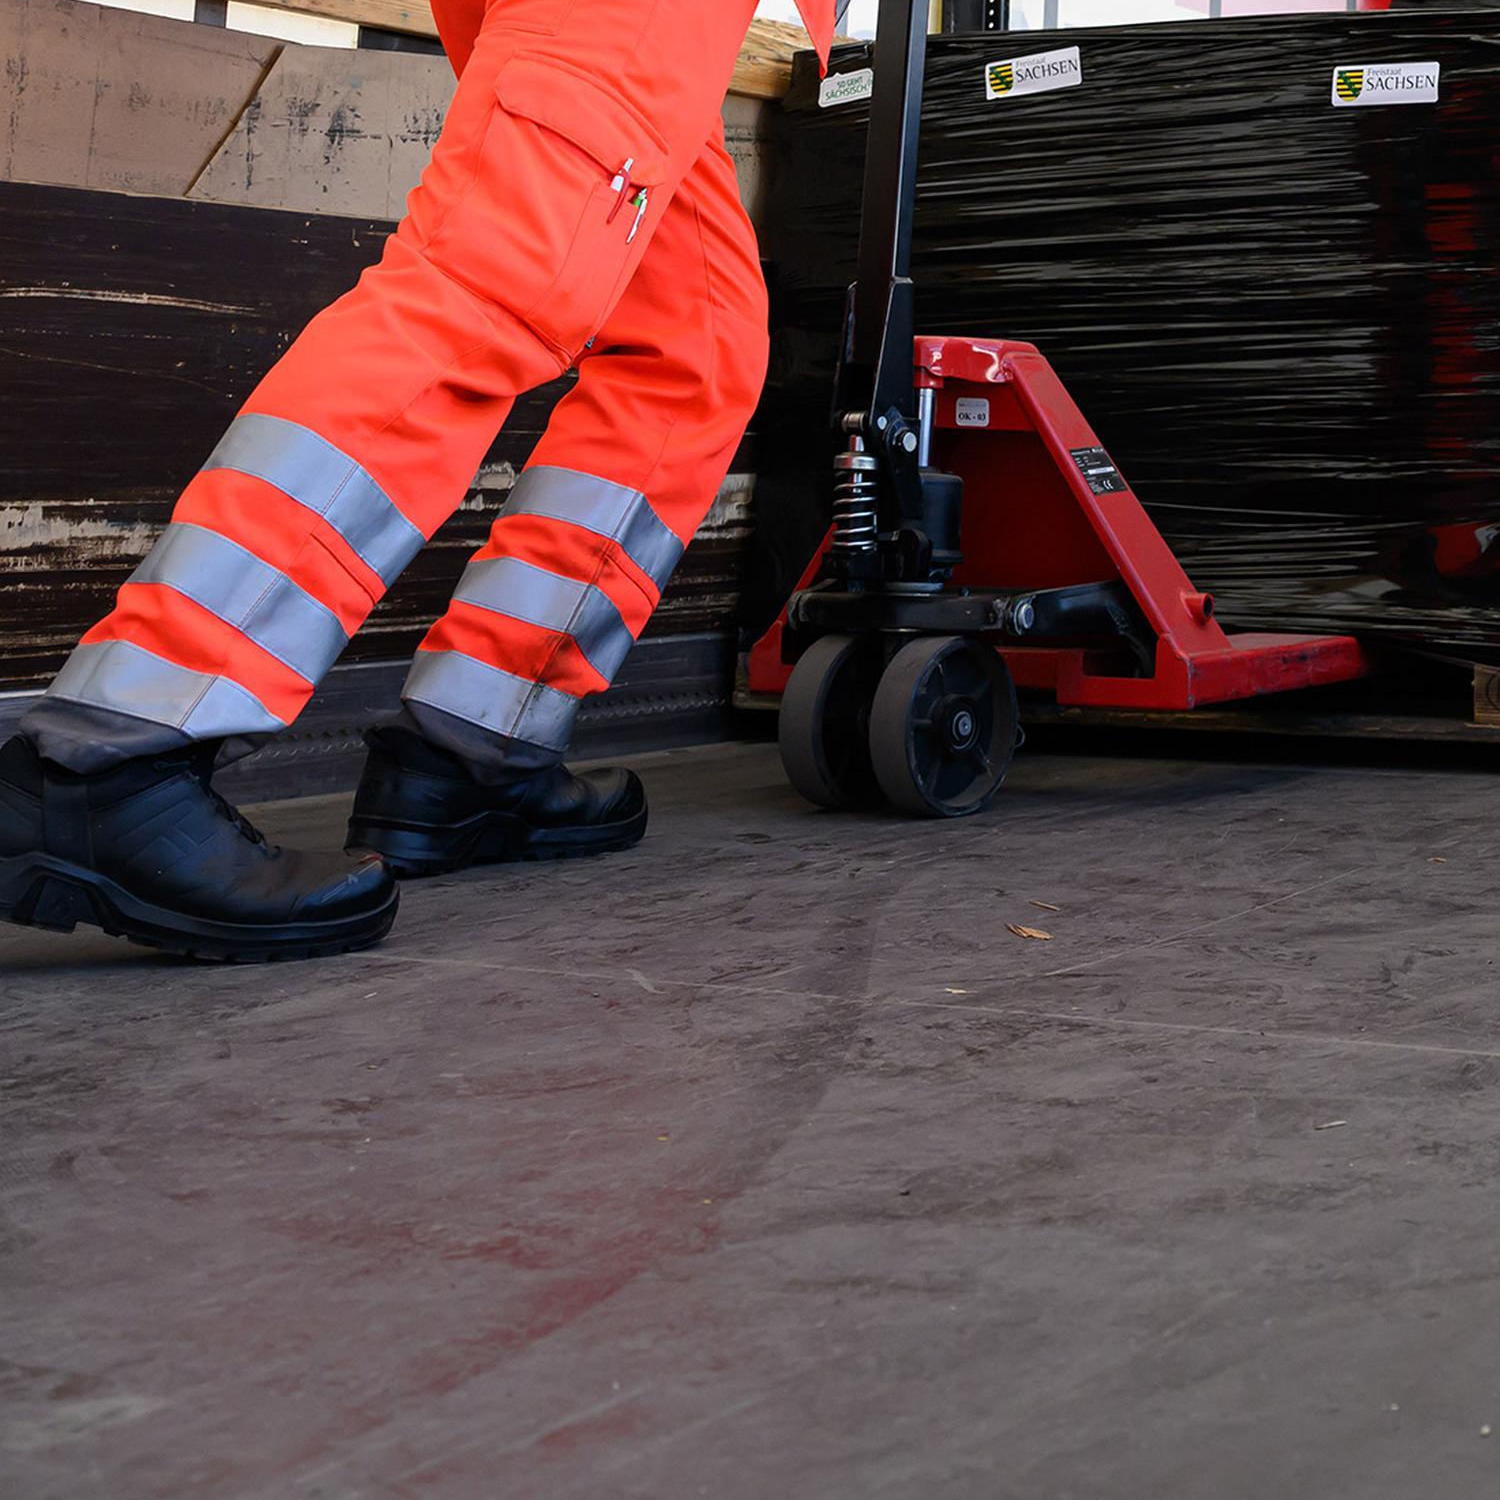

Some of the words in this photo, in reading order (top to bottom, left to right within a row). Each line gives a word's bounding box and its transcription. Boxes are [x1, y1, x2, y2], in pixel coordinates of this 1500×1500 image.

[1016, 59, 1079, 83] SACHSEN
[1367, 68, 1402, 76] Freistaat
[1366, 74, 1436, 92] SACHSEN
